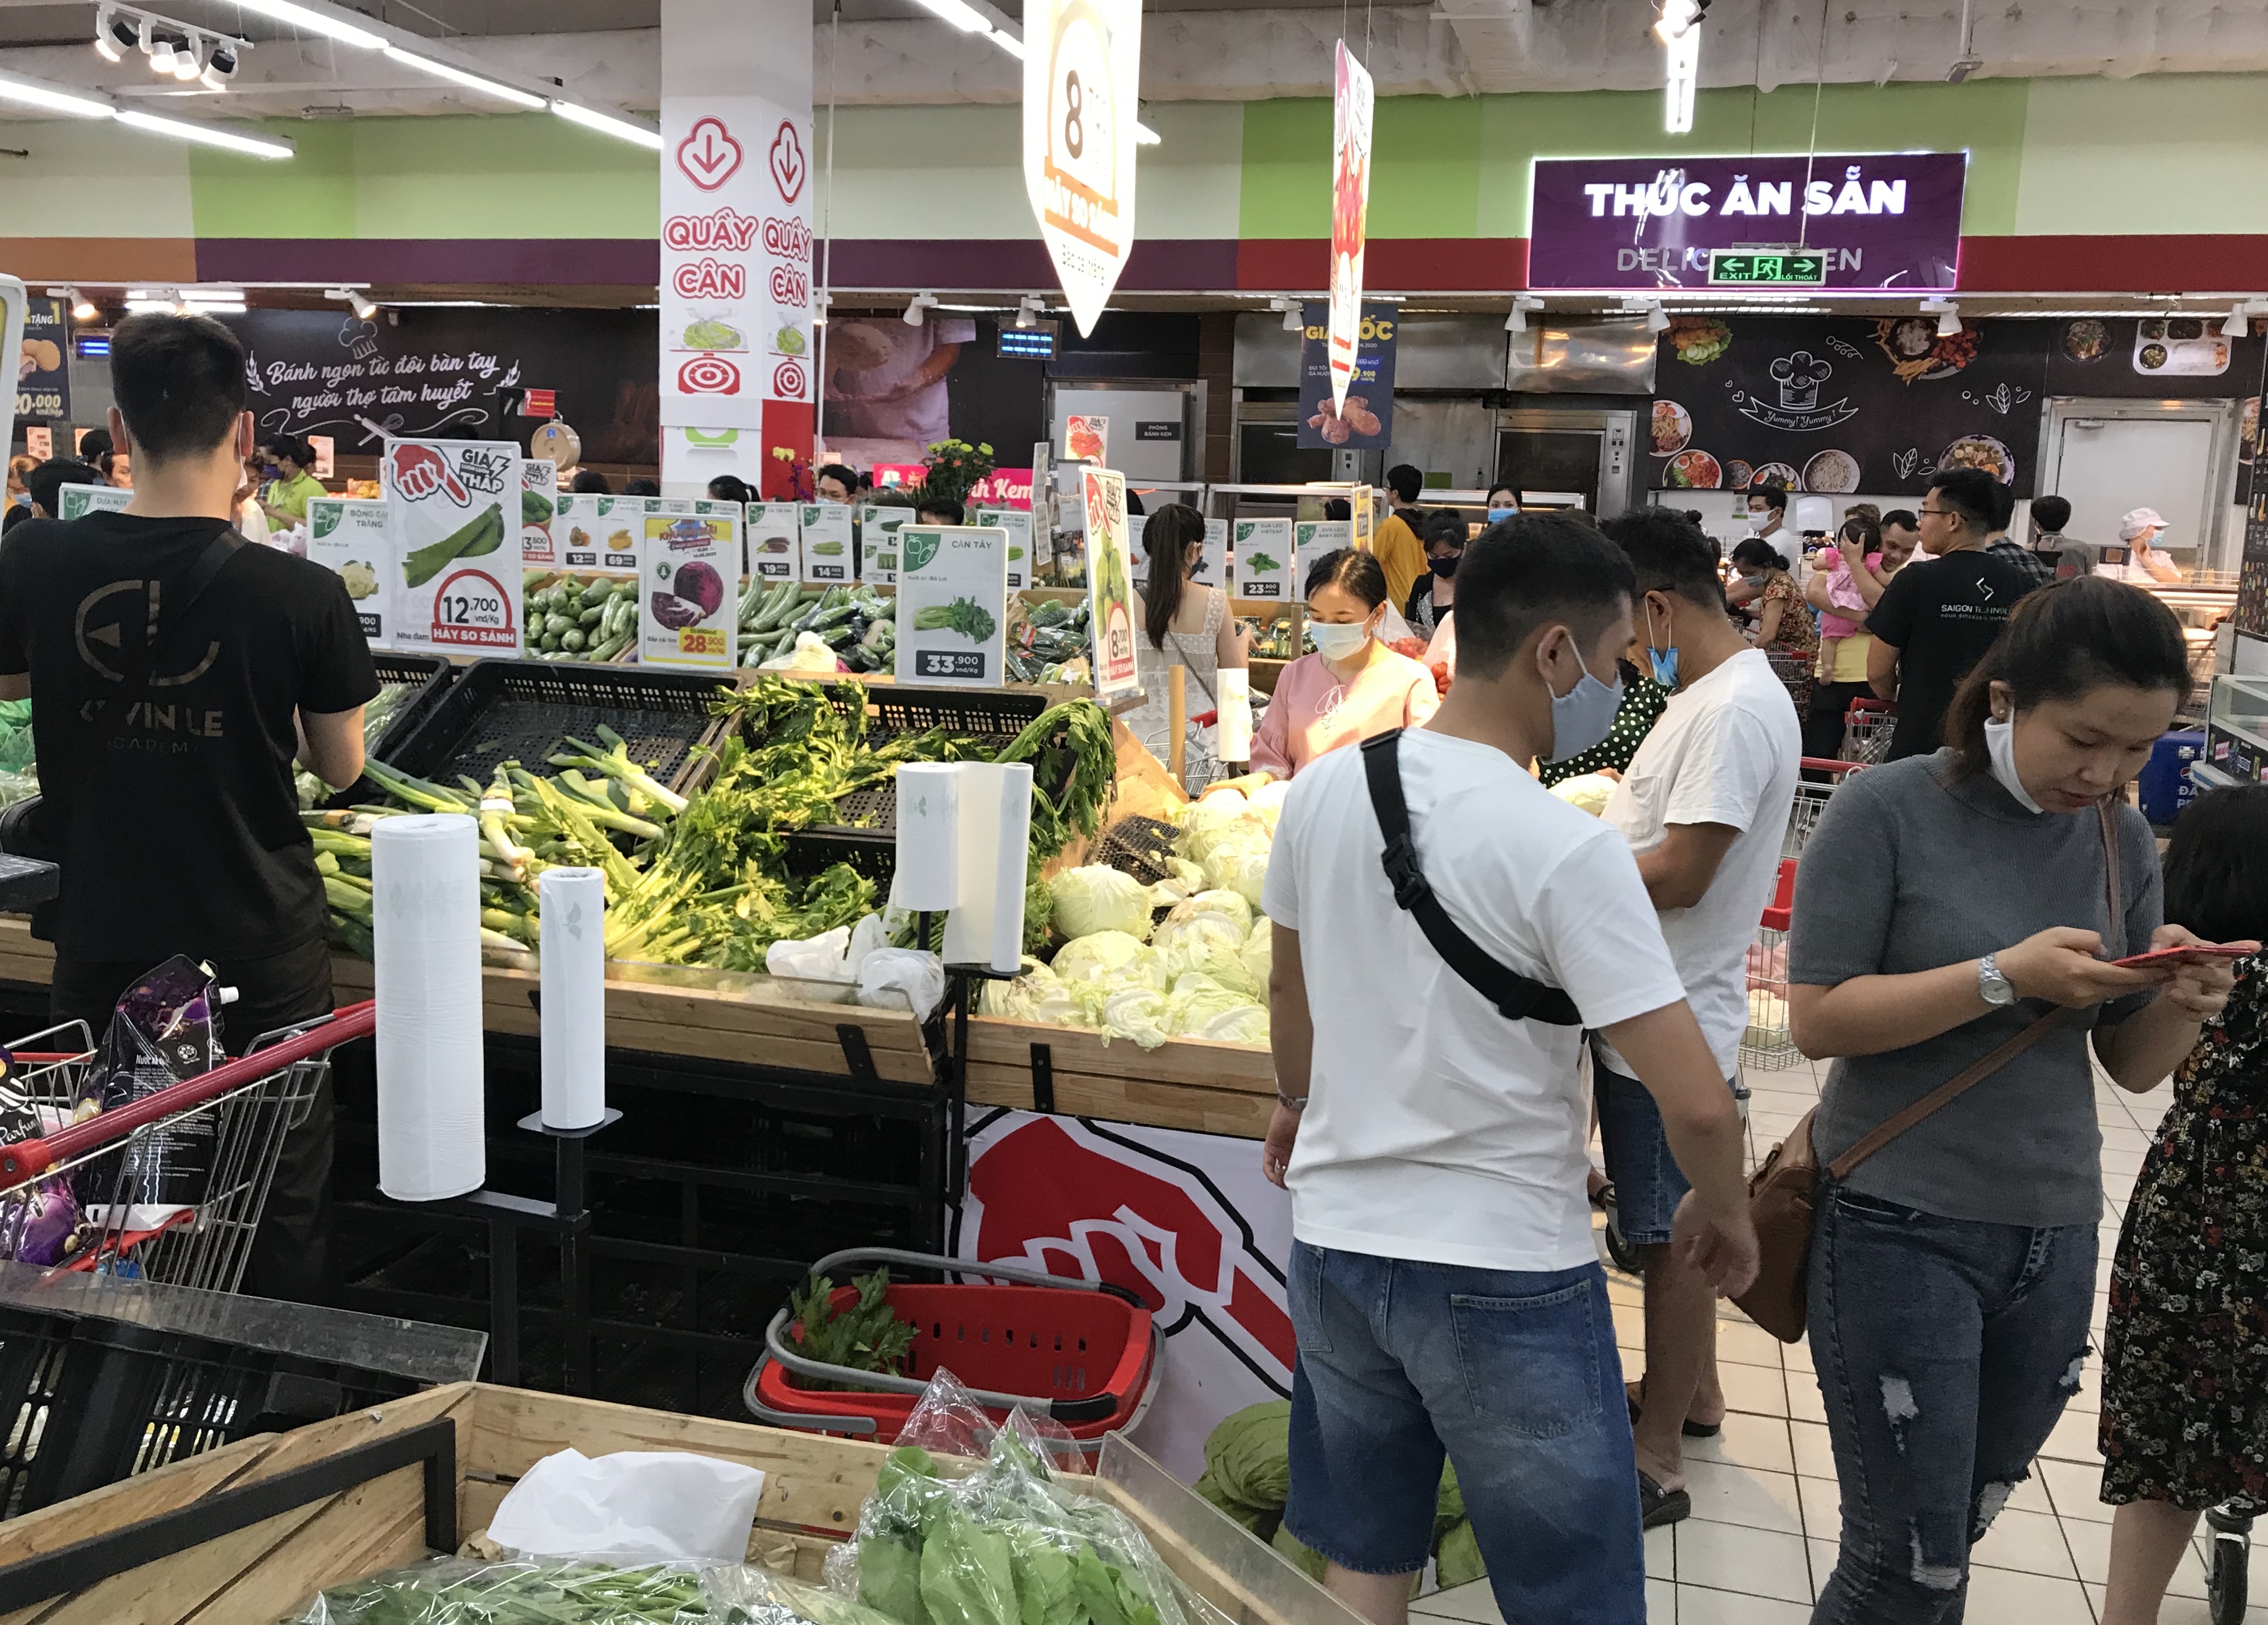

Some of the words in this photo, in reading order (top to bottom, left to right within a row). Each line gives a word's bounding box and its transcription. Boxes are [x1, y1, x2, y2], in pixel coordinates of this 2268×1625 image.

[1584, 169, 1711, 216] THỨC
[1720, 174, 1792, 216] ĂN
[1803, 165, 1908, 215] SẴN
[676, 260, 743, 297] CÂN
[771, 265, 807, 306] CÂN
[1781, 272, 1794, 281] LỐI
[31, 313, 53, 326] TẶNG
[50, 301, 61, 324] 1
[1359, 314, 1394, 340] ỐC
[267, 361, 319, 385] Bánh
[395, 357, 424, 375] đôi
[430, 353, 464, 372] bàn
[468, 351, 500, 378] tay
[292, 388, 342, 418] người
[346, 388, 376, 409] thợ
[381, 385, 417, 404] tâm
[421, 378, 474, 409] huyết
[461, 447, 491, 467] GIÁ
[460, 472, 504, 494] THẤP
[994, 478, 1032, 499] Kem
[974, 539, 992, 549] TÂY
[1941, 604, 1973, 612] SAIGON
[1974, 605, 2011, 615] TEHNOL
[433, 627, 460, 640] HÃY
[461, 629, 477, 641] SO
[480, 629, 514, 644] SÁNH
[926, 654, 978, 674] 33.900
[109, 737, 199, 754] CADEMY
